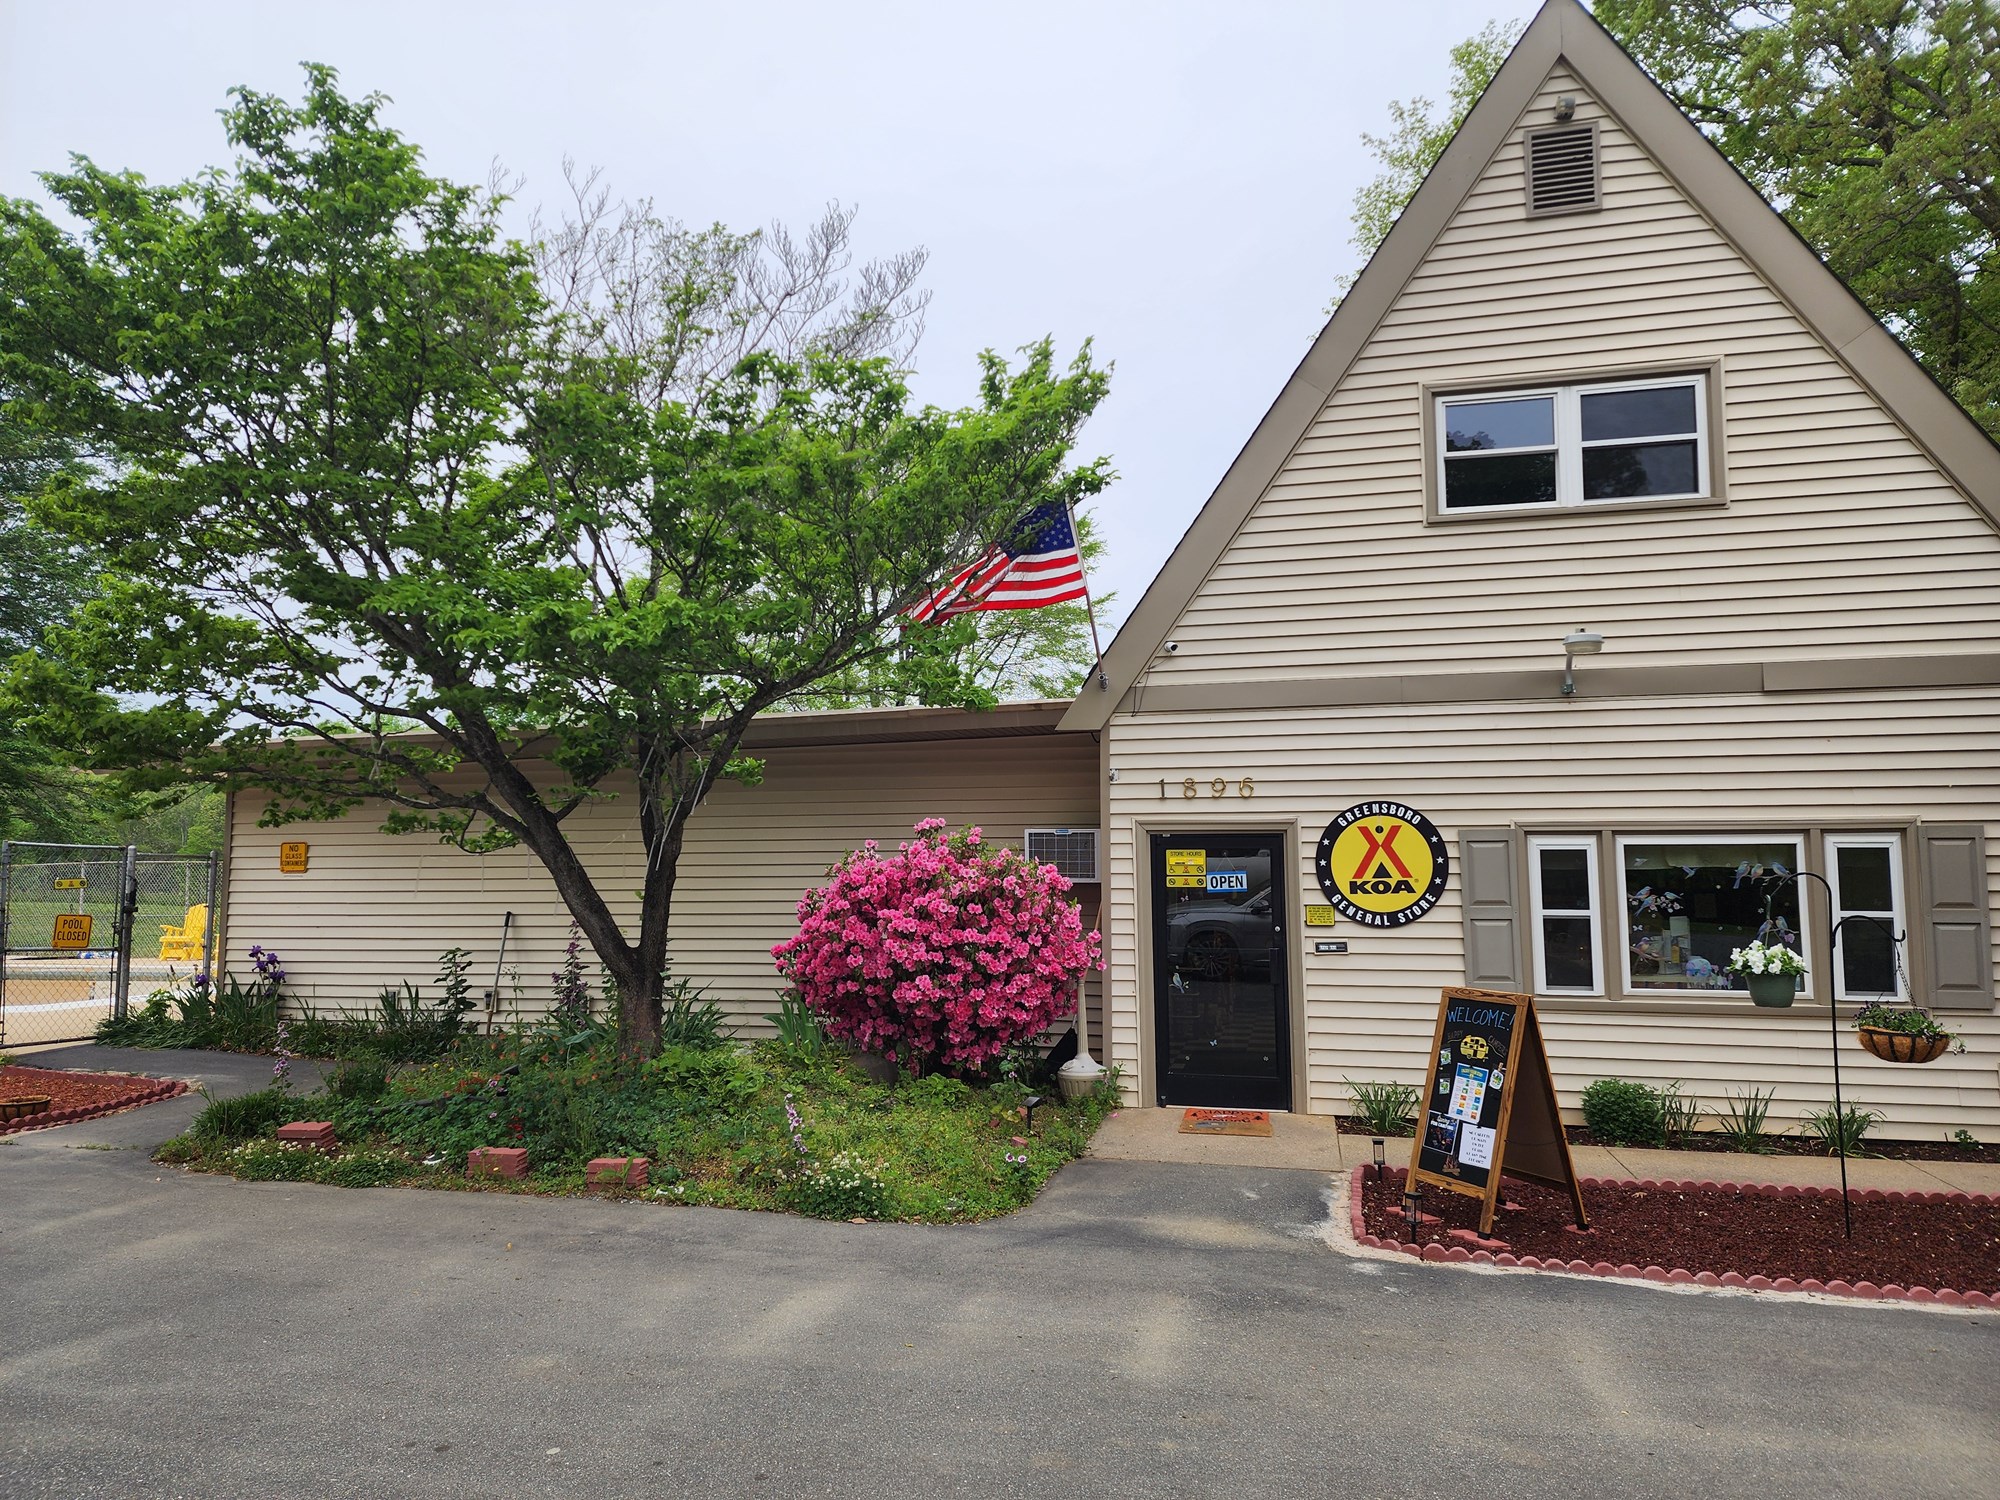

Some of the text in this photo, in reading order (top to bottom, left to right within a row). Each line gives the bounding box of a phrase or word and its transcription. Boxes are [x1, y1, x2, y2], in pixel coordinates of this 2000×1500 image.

[1159, 777, 1254, 799] 1896
[1338, 803, 1421, 827] GREENSBORO
[1210, 875, 1244, 889] OPEN
[1349, 880, 1417, 895] KOA
[1331, 893, 1390, 926] GENERAL
[1397, 892, 1436, 923] STORE
[62, 919, 83, 930] POOL
[57, 930, 87, 941] CLOSED
[1446, 1006, 1516, 1031] WELCOME!
